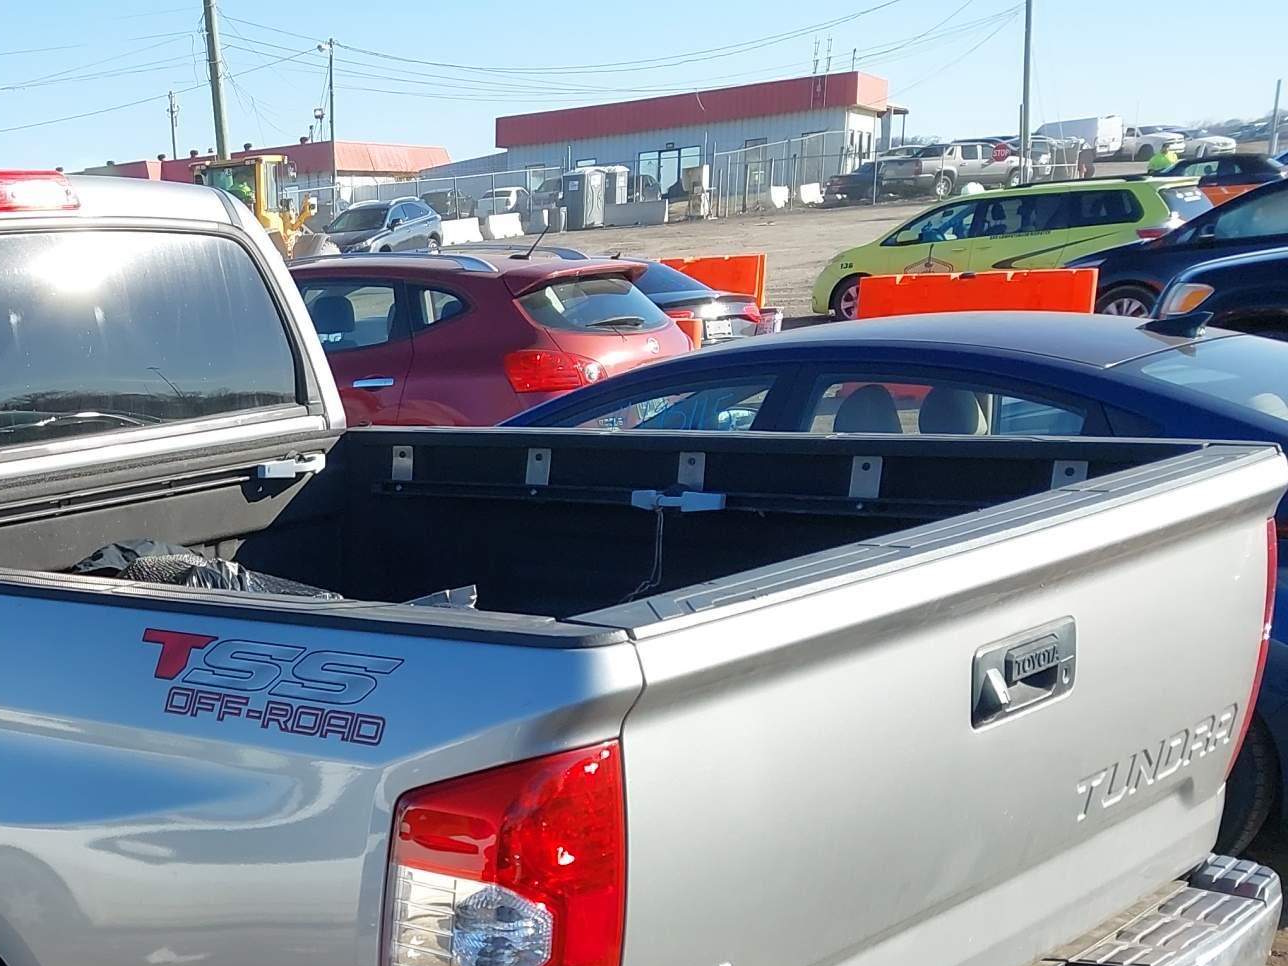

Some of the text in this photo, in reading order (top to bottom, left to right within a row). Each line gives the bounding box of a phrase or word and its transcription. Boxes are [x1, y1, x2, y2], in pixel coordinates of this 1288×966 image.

[993, 149, 1010, 157] STOP
[1015, 645, 1060, 676] TOYOTA
[164, 686, 386, 746] OFF-ROAD
[1077, 703, 1238, 822] TUNDRA
